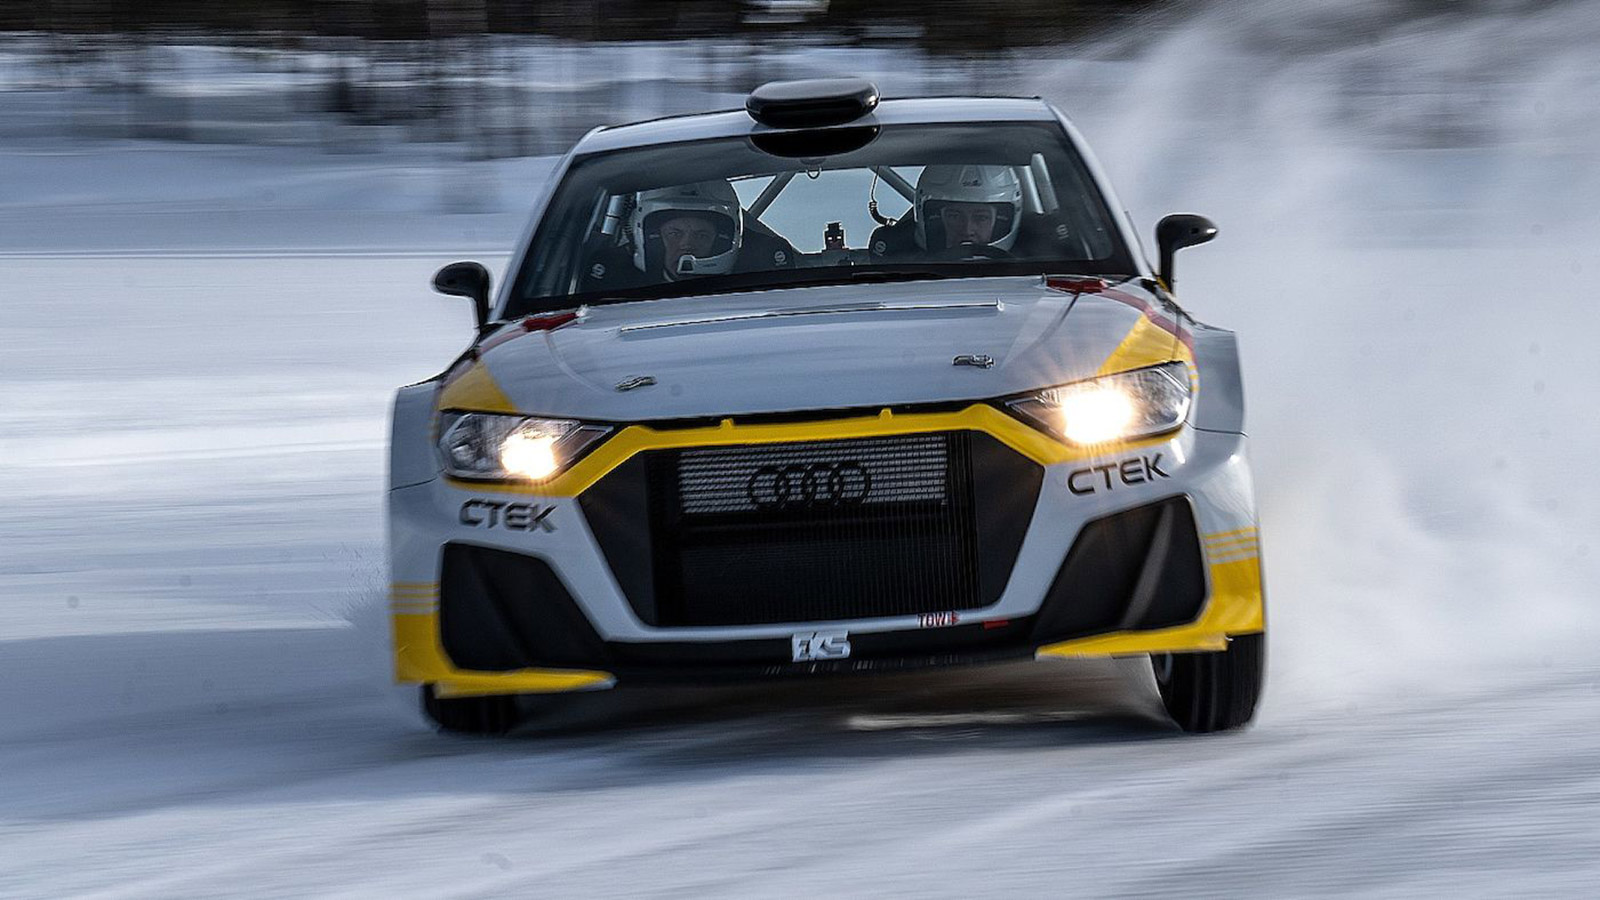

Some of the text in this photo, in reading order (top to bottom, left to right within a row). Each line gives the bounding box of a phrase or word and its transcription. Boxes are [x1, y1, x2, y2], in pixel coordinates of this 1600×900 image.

[1067, 453, 1170, 494] CTEK
[459, 498, 558, 533] CTEK
[917, 611, 946, 628] TOW
[792, 630, 851, 662] EKS
